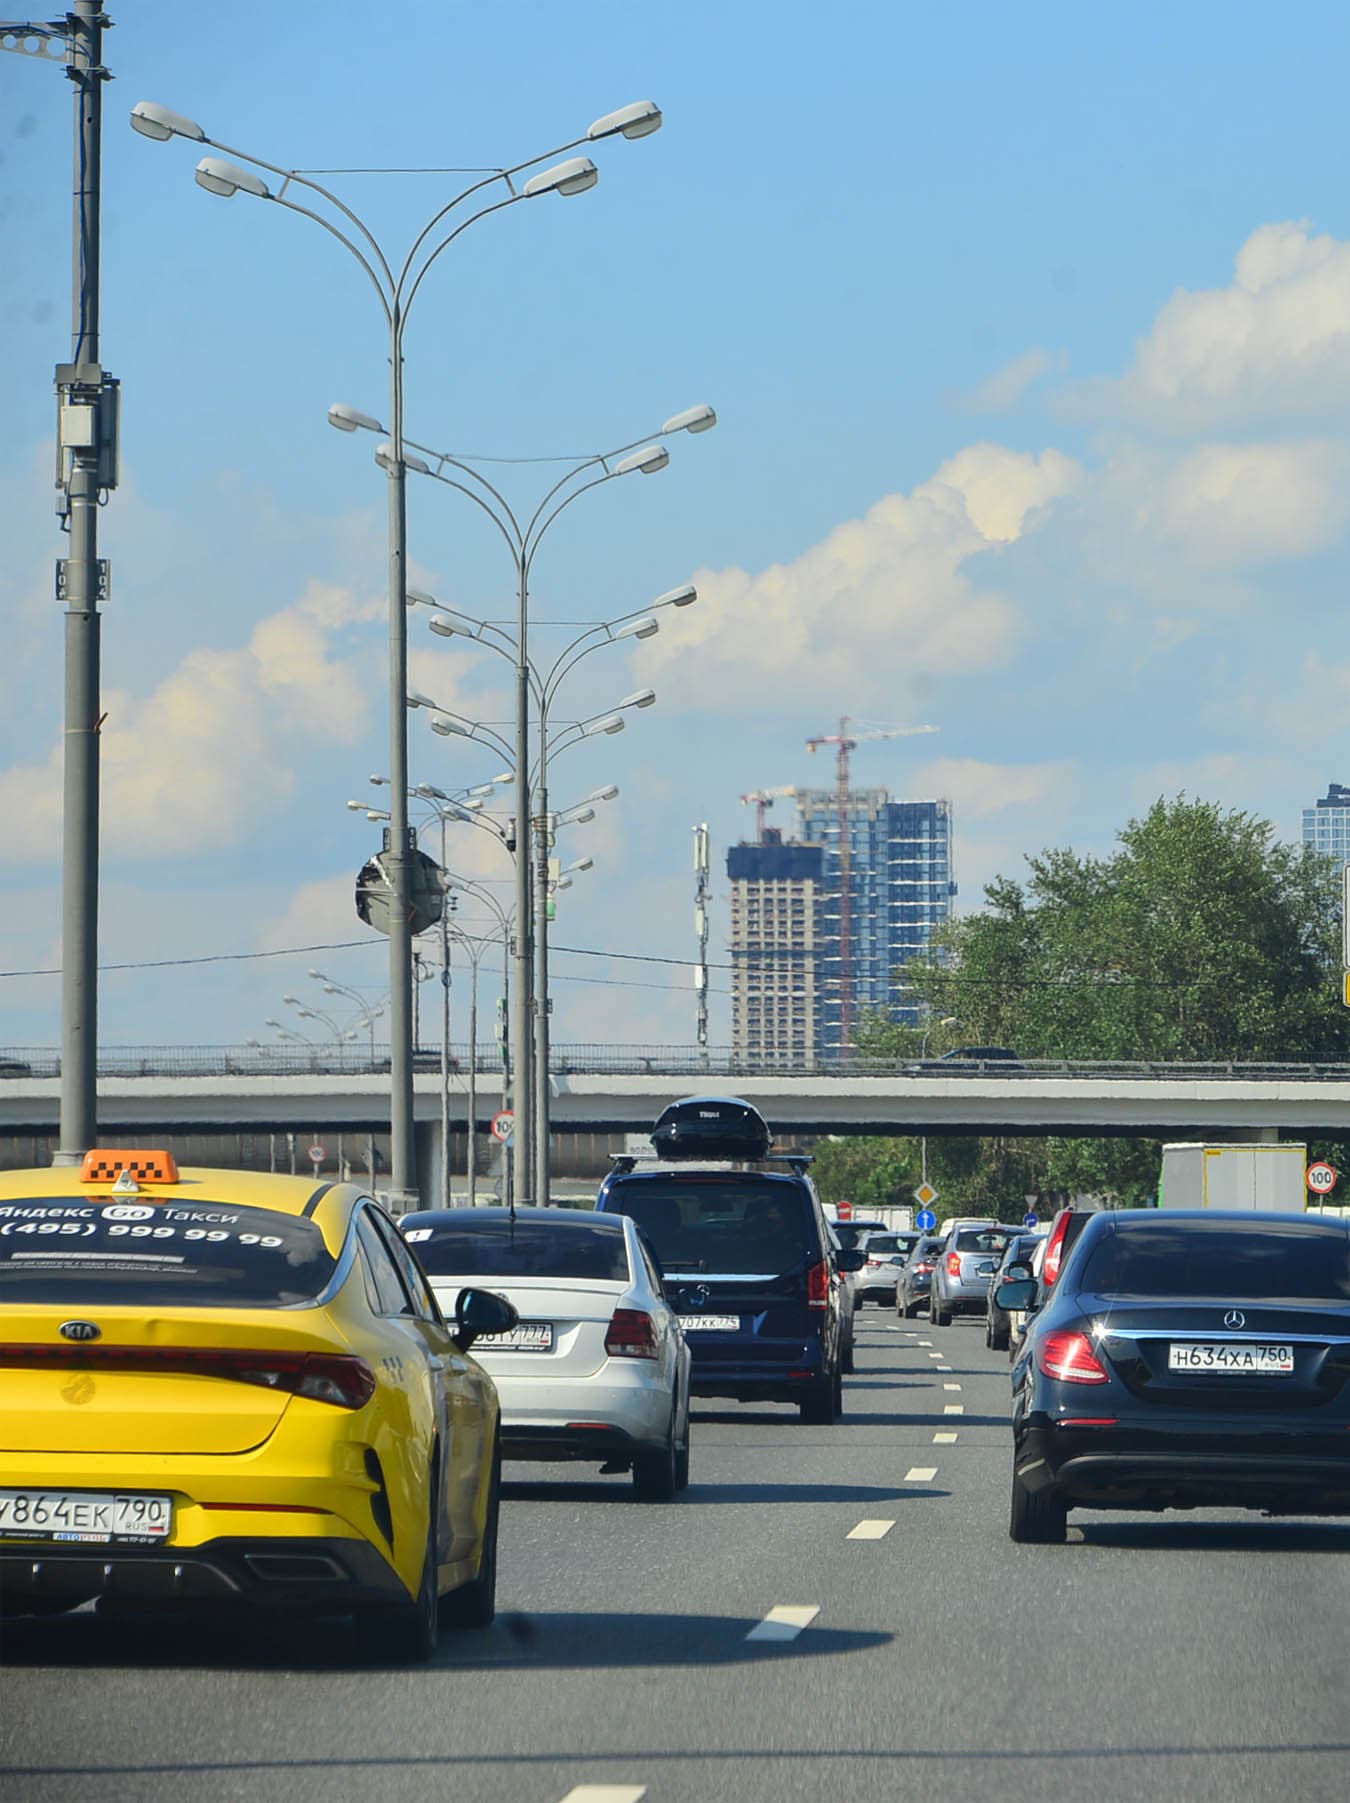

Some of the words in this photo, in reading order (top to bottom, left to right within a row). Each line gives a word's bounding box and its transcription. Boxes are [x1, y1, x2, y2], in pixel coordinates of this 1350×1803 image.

[1311, 1171, 1332, 1184] 100
[0, 1206, 94, 1219] Яндекс
[163, 1208, 240, 1224] Такси
[0, 1222, 97, 1236] (495)
[108, 1225, 175, 1239] 999
[184, 1229, 229, 1242] 99
[239, 1233, 283, 1247] 99
[65, 1325, 94, 1338] KIA
[522, 1325, 546, 1339] 777
[1177, 1346, 1254, 1367] Н634ХА
[1258, 1347, 1287, 1362] 750
[117, 1498, 162, 1521] 790
[125, 1521, 148, 1531] RUS
